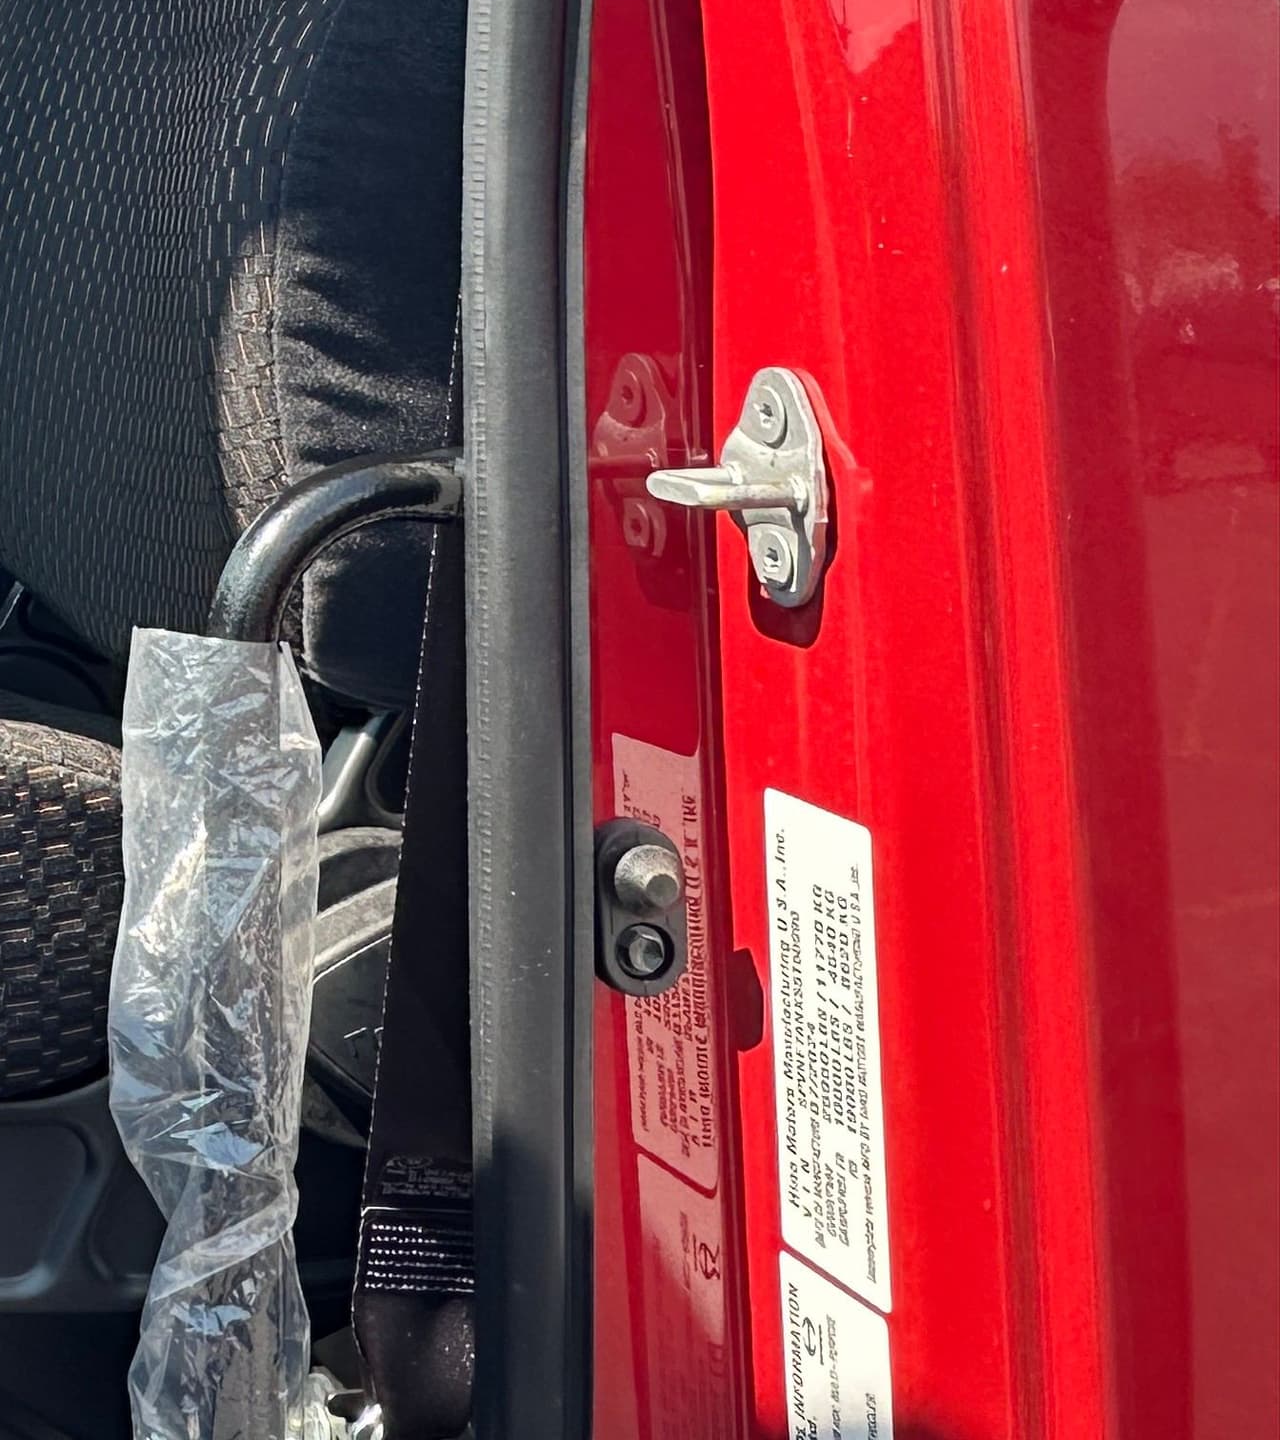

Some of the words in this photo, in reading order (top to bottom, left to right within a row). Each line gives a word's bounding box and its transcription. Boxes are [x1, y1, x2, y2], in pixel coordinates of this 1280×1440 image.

[785, 1087, 797, 1155] Motors
[788, 1161, 800, 1208] Hino
[788, 1283, 805, 1420] INFORMATION
